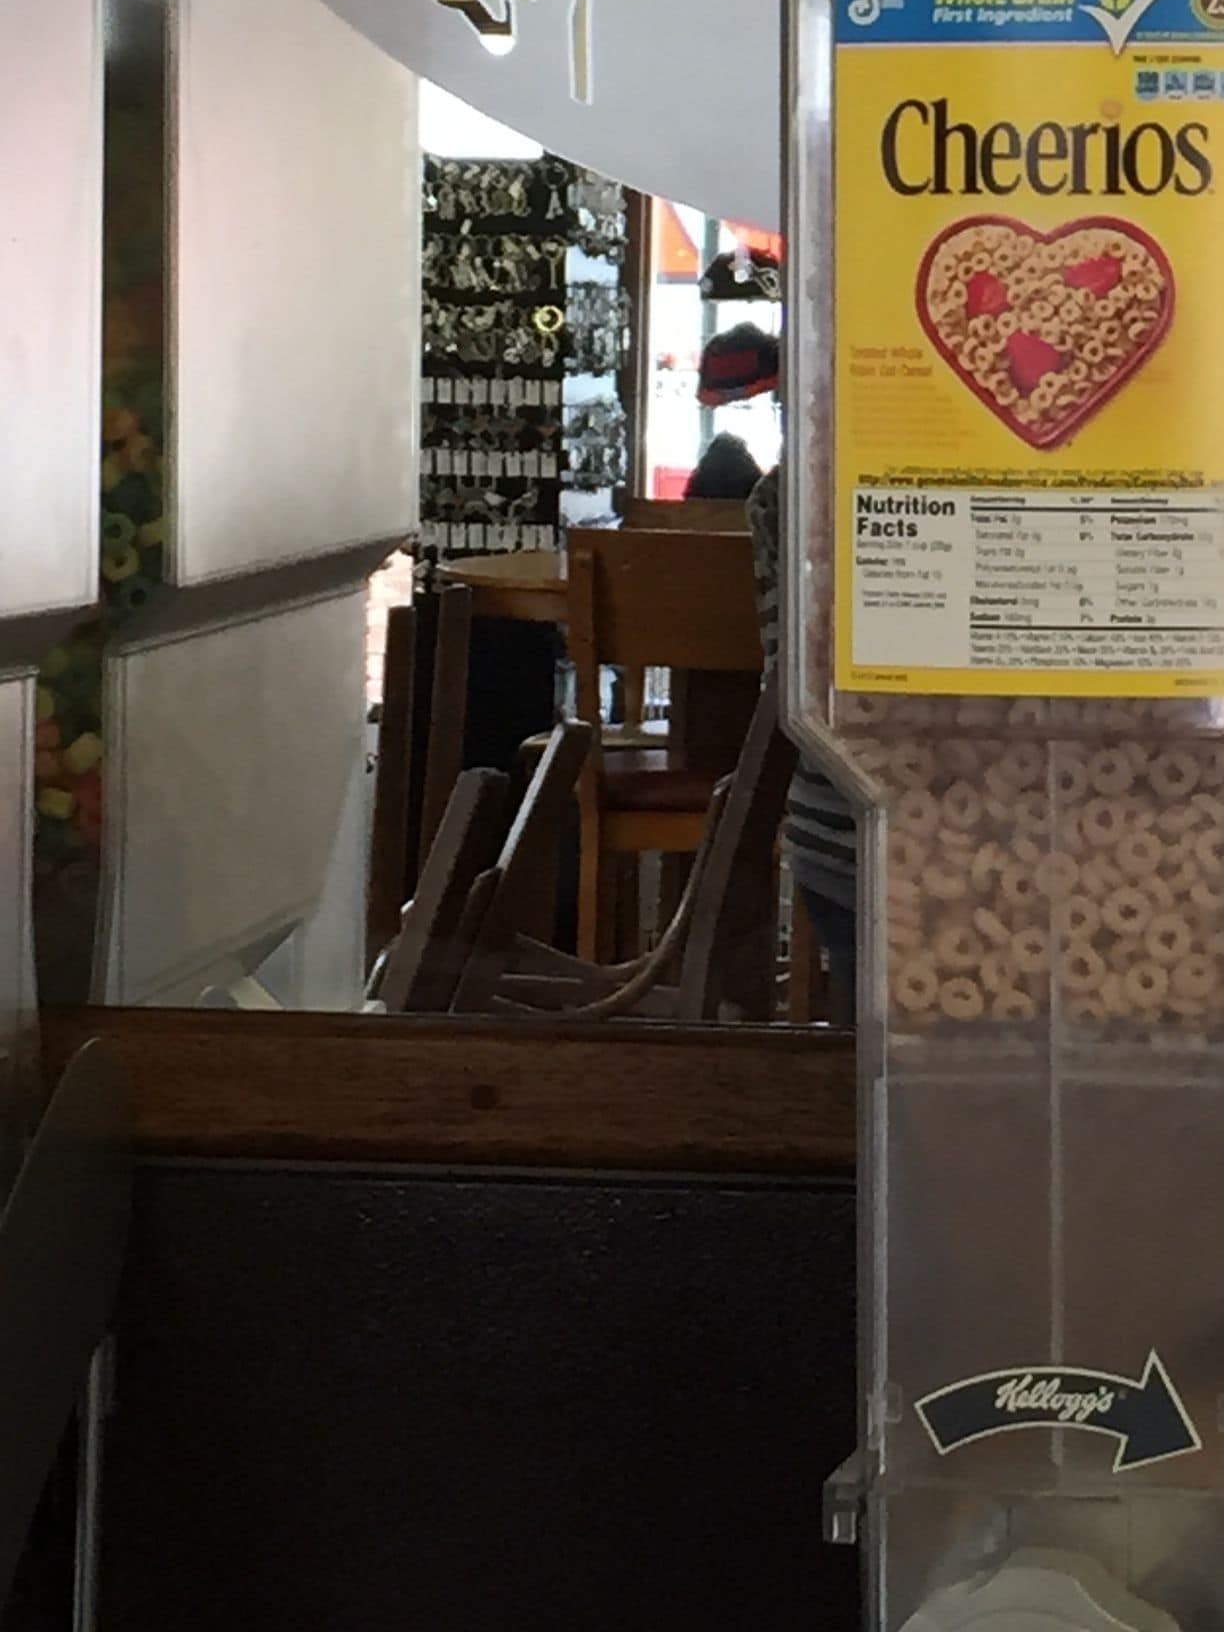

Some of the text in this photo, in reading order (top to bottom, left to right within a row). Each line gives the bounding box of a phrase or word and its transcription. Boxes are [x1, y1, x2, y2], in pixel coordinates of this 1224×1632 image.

[931, 8, 1074, 27] First Ingredient
[881, 97, 1213, 197] Cheerios
[857, 494, 956, 516] Nutrition
[857, 516, 918, 538] Facts
[995, 1373, 1115, 1422] Kellogg's
